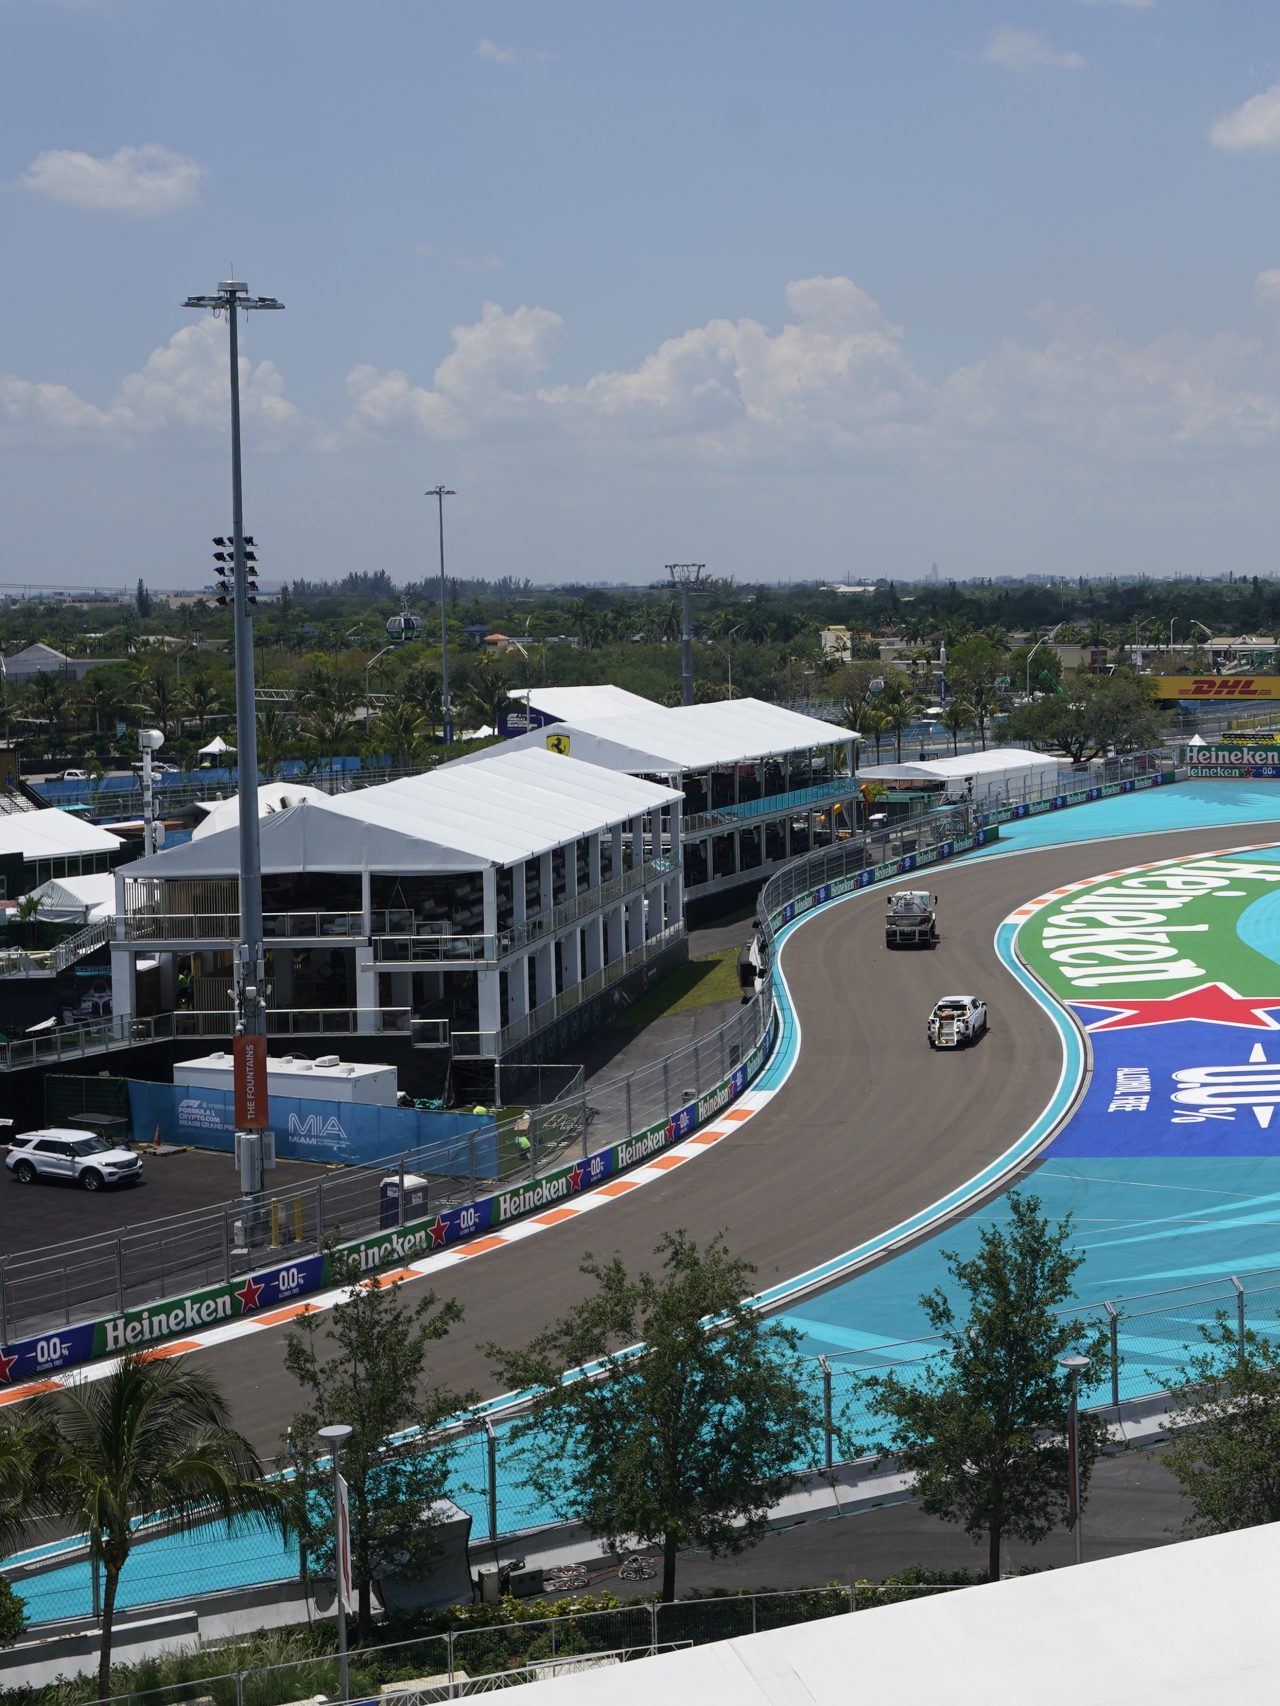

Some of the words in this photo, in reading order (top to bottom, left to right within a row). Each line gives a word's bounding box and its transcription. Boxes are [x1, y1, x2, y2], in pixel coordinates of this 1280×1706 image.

[1191, 680, 1259, 695] DHL
[1184, 747, 1279, 765] Heineken
[246, 1044, 255, 1099] FOUNTAINS
[1114, 1067, 1151, 1095] ALCOHOL
[179, 1107, 210, 1116] FORMULA
[247, 1101, 256, 1120] THE
[1107, 1094, 1151, 1112] FREE
[201, 1121, 223, 1130] GRAND
[288, 1113, 348, 1139] MIA
[288, 1135, 317, 1145] MIAMI
[105, 1294, 232, 1351] Heineken
[334, 1230, 427, 1277] eineken
[499, 1177, 567, 1221] Heineken
[618, 1129, 665, 1168] Heineken
[698, 1088, 729, 1121] Heineken
